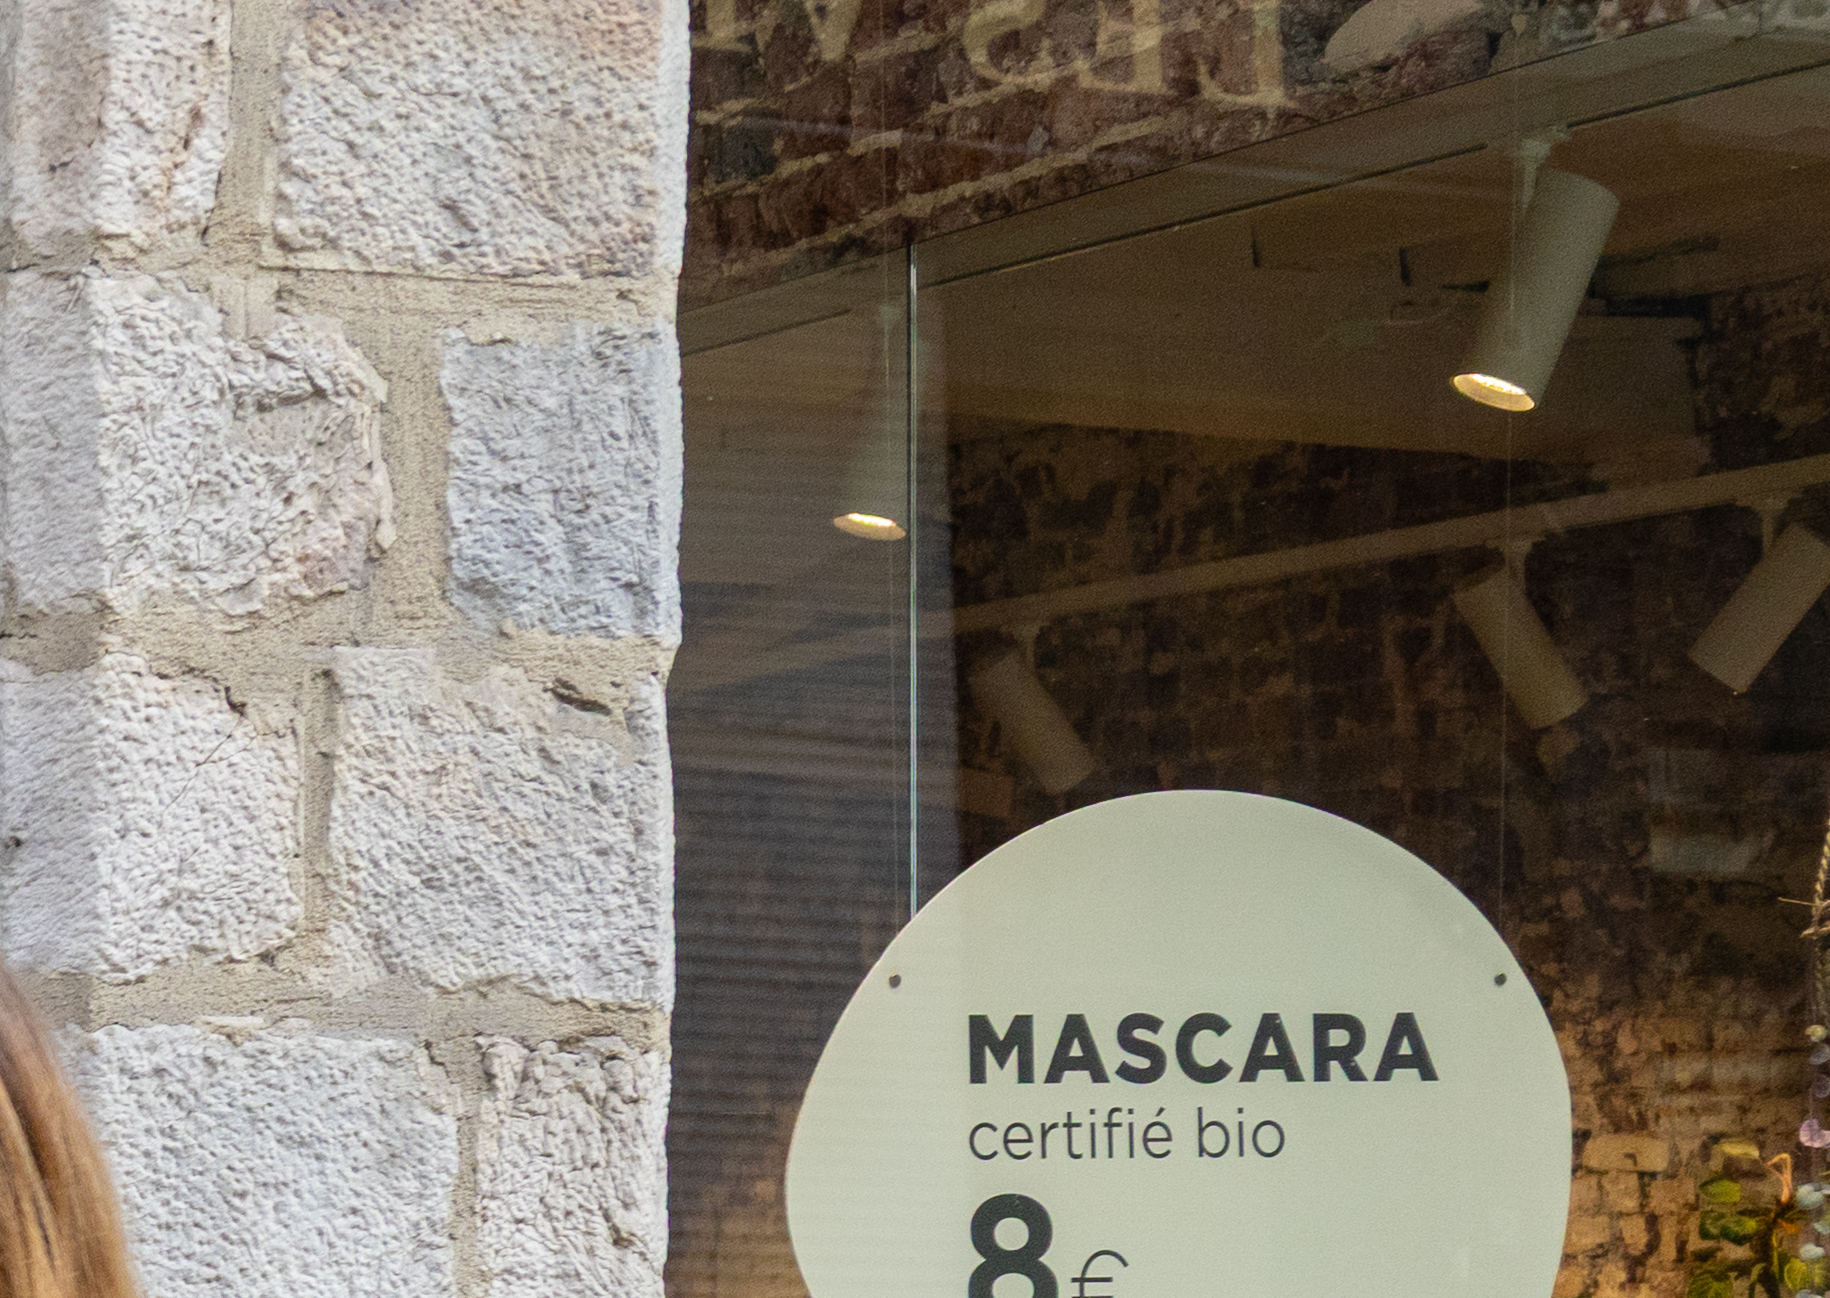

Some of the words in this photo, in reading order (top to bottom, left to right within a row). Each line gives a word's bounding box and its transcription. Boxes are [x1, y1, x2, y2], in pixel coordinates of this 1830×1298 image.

[968, 1012, 1439, 1084] MASCARA
[969, 1107, 1173, 1160] certifié
[1197, 1107, 1286, 1159] bio
